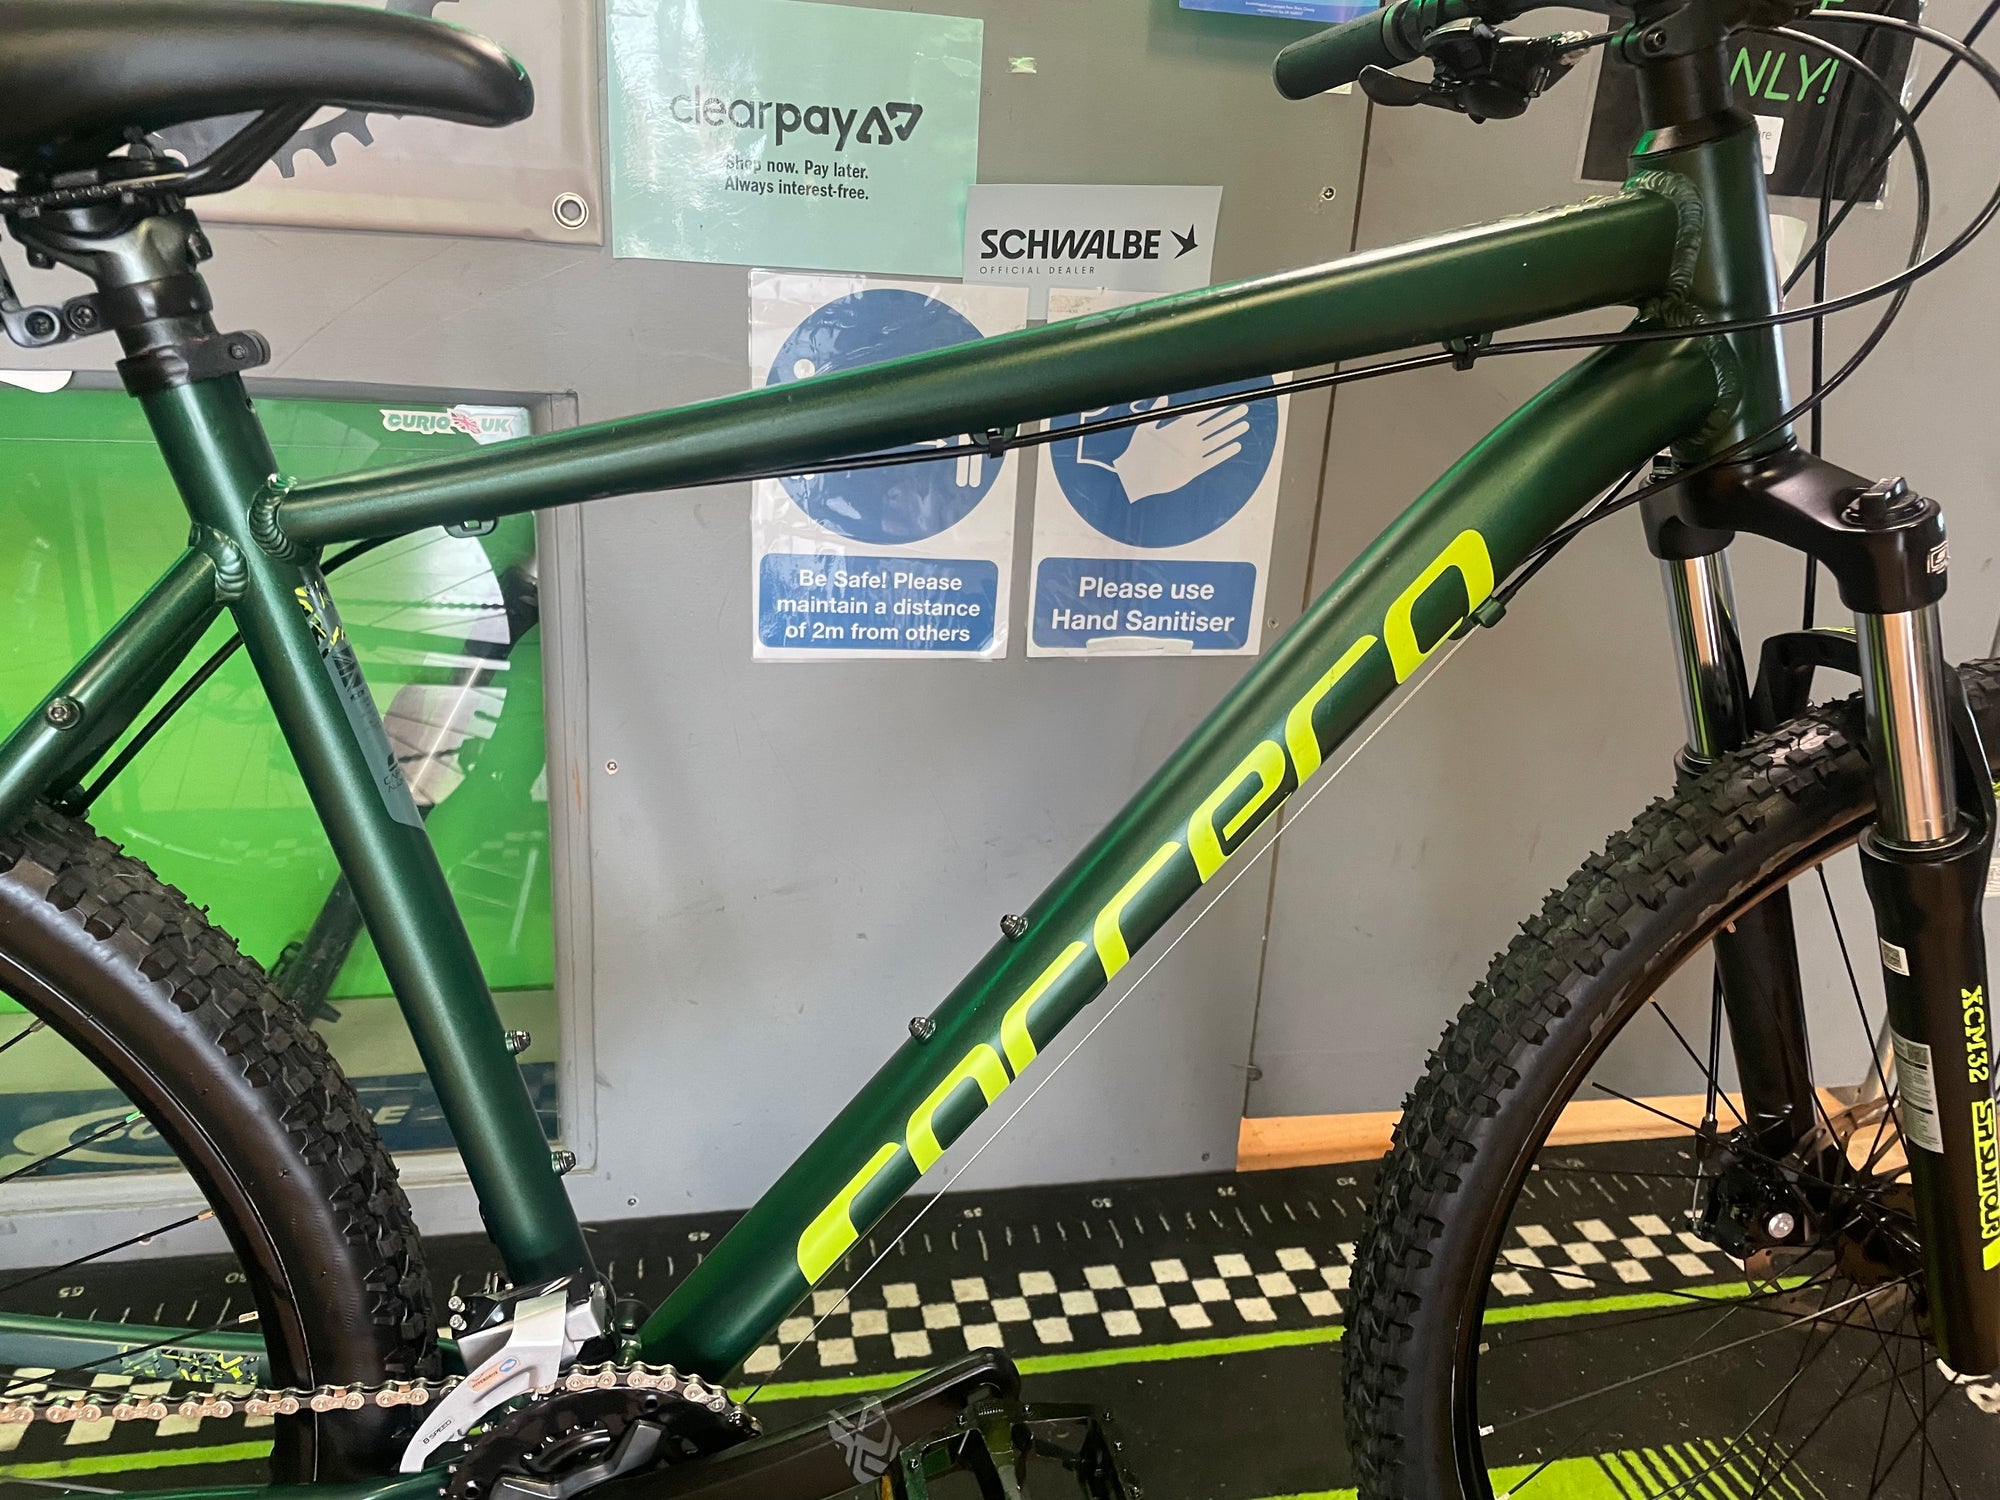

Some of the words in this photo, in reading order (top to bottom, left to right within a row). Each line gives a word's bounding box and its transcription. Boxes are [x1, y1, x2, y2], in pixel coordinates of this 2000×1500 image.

[1730, 47, 1839, 104] NLY!
[669, 85, 858, 151] clearpay
[726, 154, 762, 174] Shop
[767, 160, 799, 175] now.
[804, 159, 830, 179] Pay
[834, 162, 870, 180] later.
[724, 175, 775, 196] Always
[778, 178, 870, 200] interest-free.
[980, 229, 1162, 260] SCHWALBE
[979, 266, 1041, 275] OFFICIAL
[1048, 266, 1096, 275] DEALER
[387, 413, 451, 432] CURIO
[480, 417, 512, 433] UK
[800, 568, 828, 588] Be
[833, 571, 888, 590] Safe!
[893, 572, 963, 591] Please
[1078, 576, 1164, 600] Please
[1170, 582, 1216, 600] use
[776, 596, 869, 615] maintain
[874, 600, 888, 616] a
[893, 598, 981, 618] distance
[785, 622, 807, 640] of
[812, 622, 845, 640] 2m
[850, 623, 900, 641] from
[904, 625, 972, 642] others
[1051, 608, 1120, 632] Hand
[1125, 609, 1237, 633] Sanitiser
[797, 528, 1496, 1286] carrera
[1961, 985, 1989, 1083] XCM32
